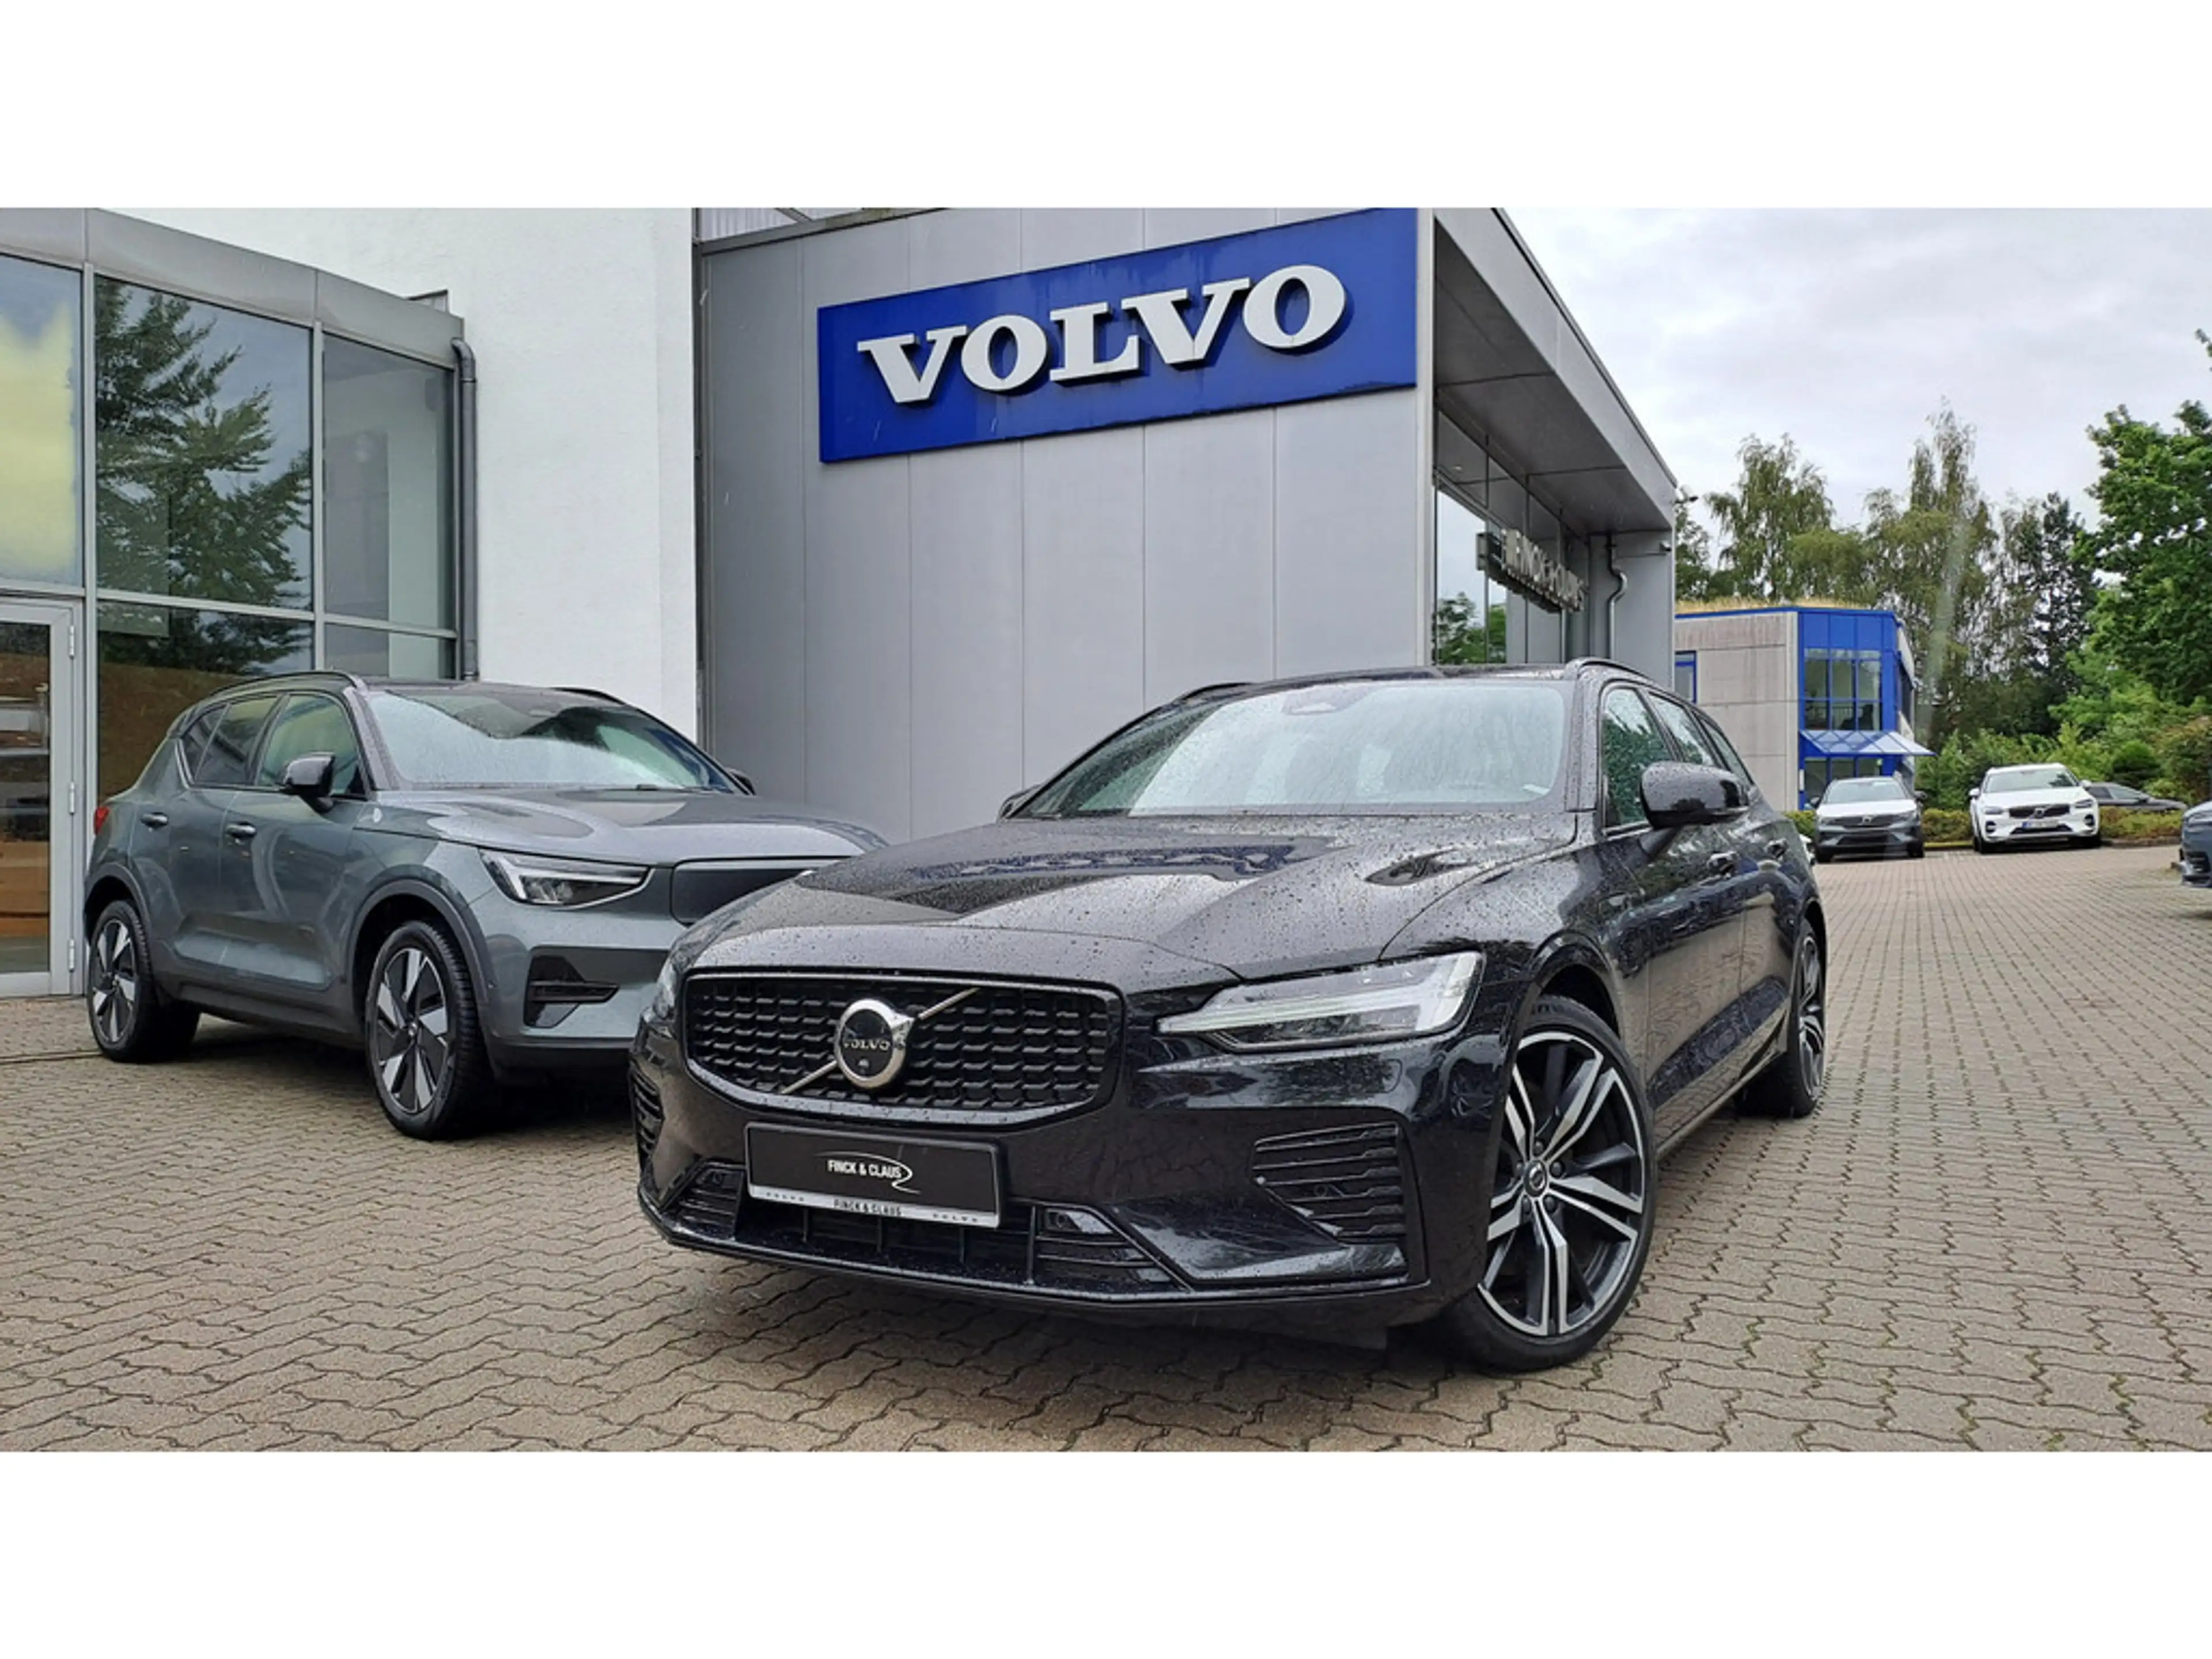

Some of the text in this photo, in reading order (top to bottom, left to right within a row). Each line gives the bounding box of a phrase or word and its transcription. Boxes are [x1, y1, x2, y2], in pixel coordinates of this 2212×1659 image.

[857, 264, 1346, 403] VOLVO
[828, 1160, 857, 1174] FINCK
[868, 1164, 902, 1179] CLAUS
